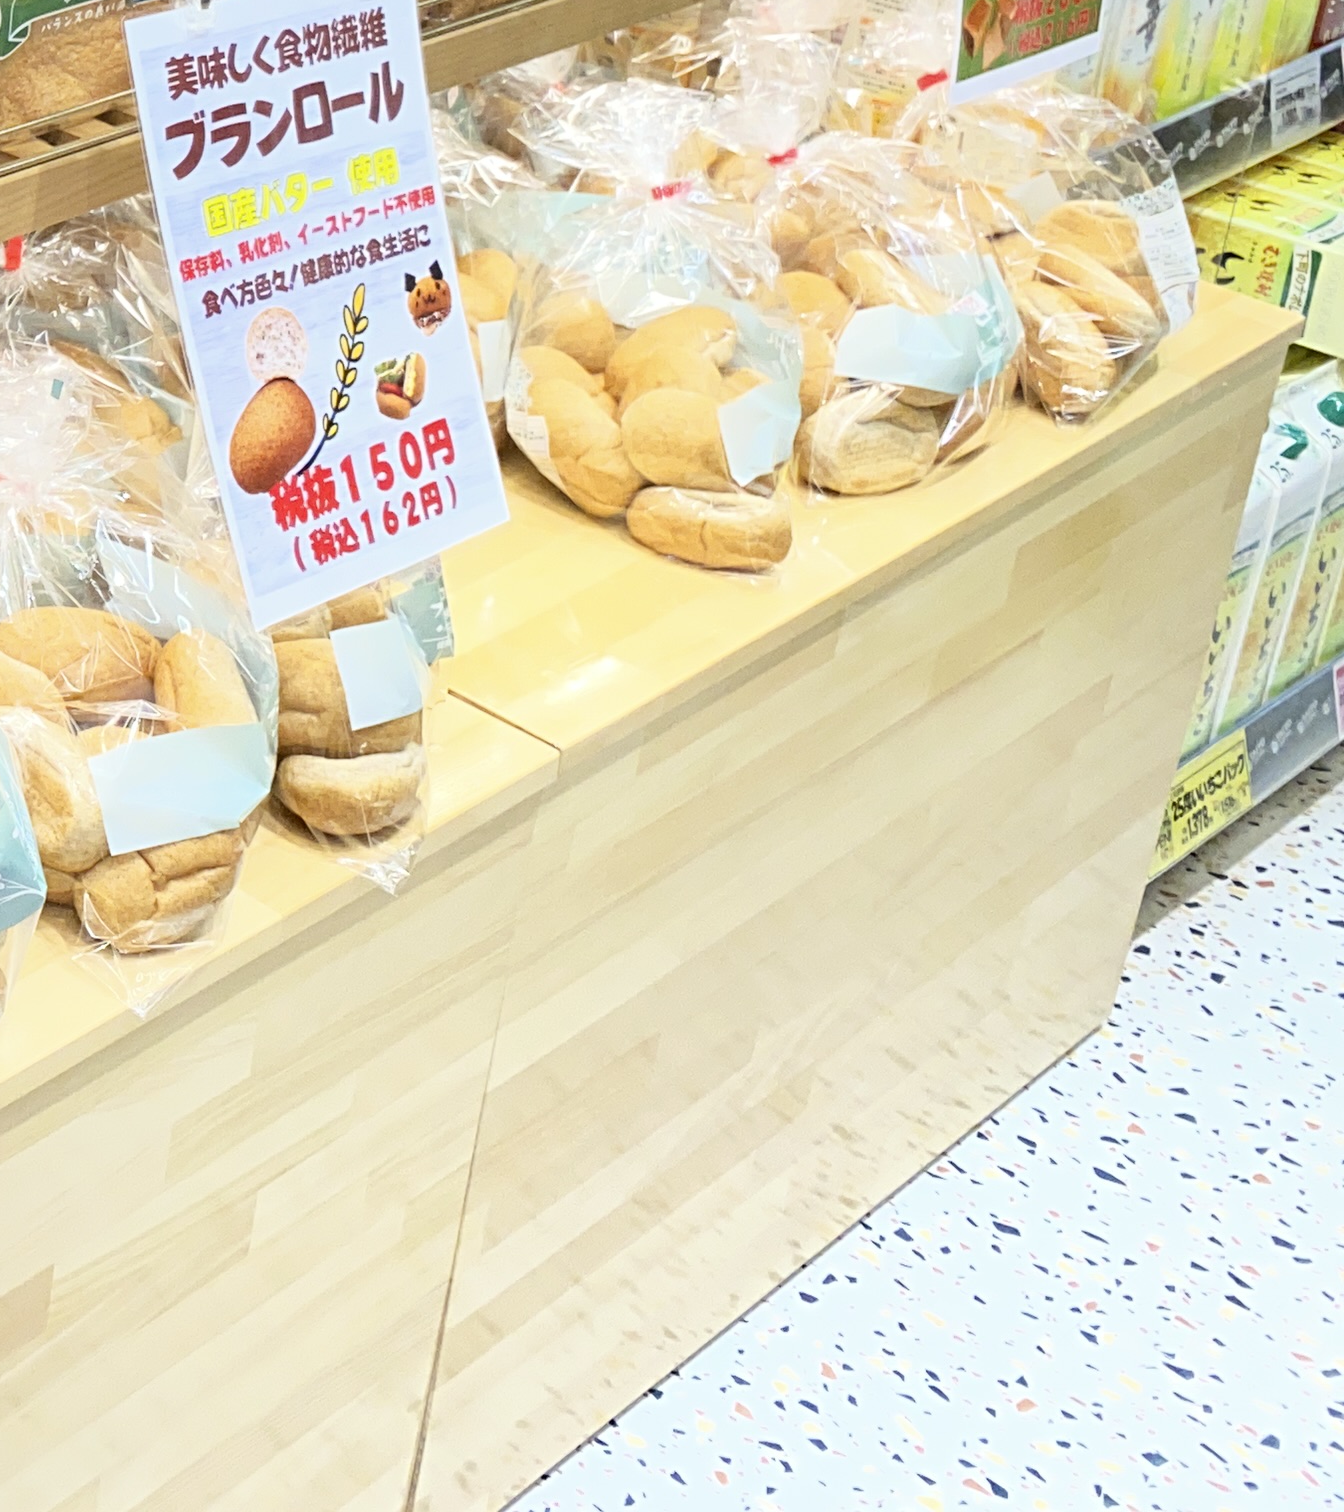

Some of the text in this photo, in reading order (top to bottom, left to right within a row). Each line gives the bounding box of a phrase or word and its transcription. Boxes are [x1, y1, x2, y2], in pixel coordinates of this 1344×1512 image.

[165, 6, 389, 100] 美味しく食物繊維
[165, 61, 407, 180] ブランロール
[201, 146, 398, 238] 国産バター 使用
[269, 418, 456, 533] 税抜150円
